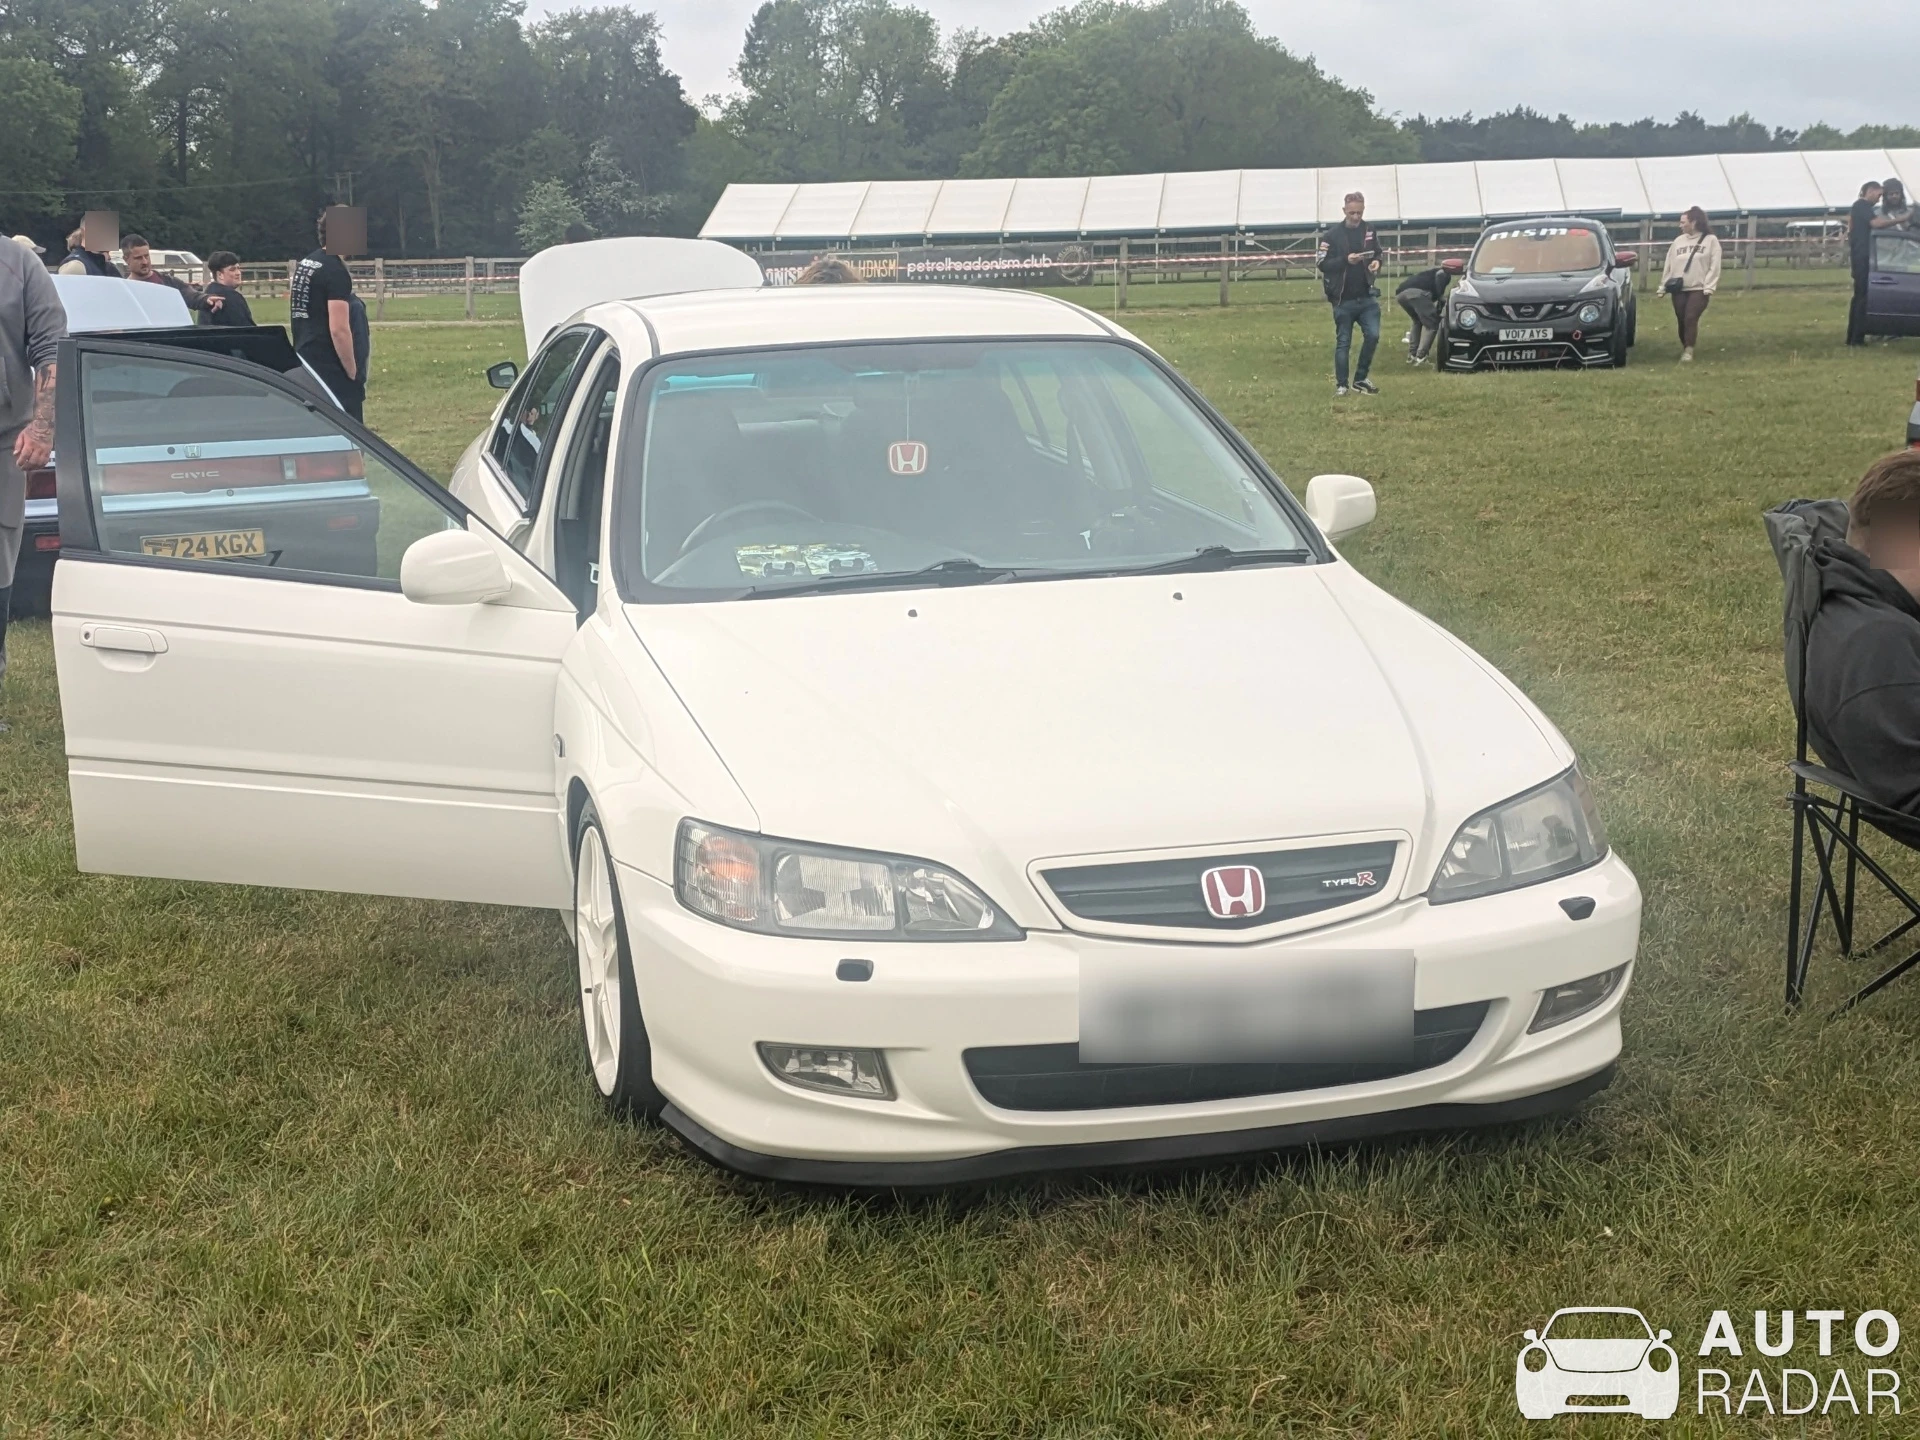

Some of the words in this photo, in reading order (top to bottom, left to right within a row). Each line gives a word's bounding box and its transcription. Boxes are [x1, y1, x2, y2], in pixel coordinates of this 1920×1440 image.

[907, 254, 1053, 277] petrolheadonism.club
[1529, 329, 1548, 339] AYS
[171, 471, 219, 479] CIVIC
[214, 533, 257, 555] KGX
[1322, 878, 1357, 887] TYPE
[1357, 871, 1377, 886] R
